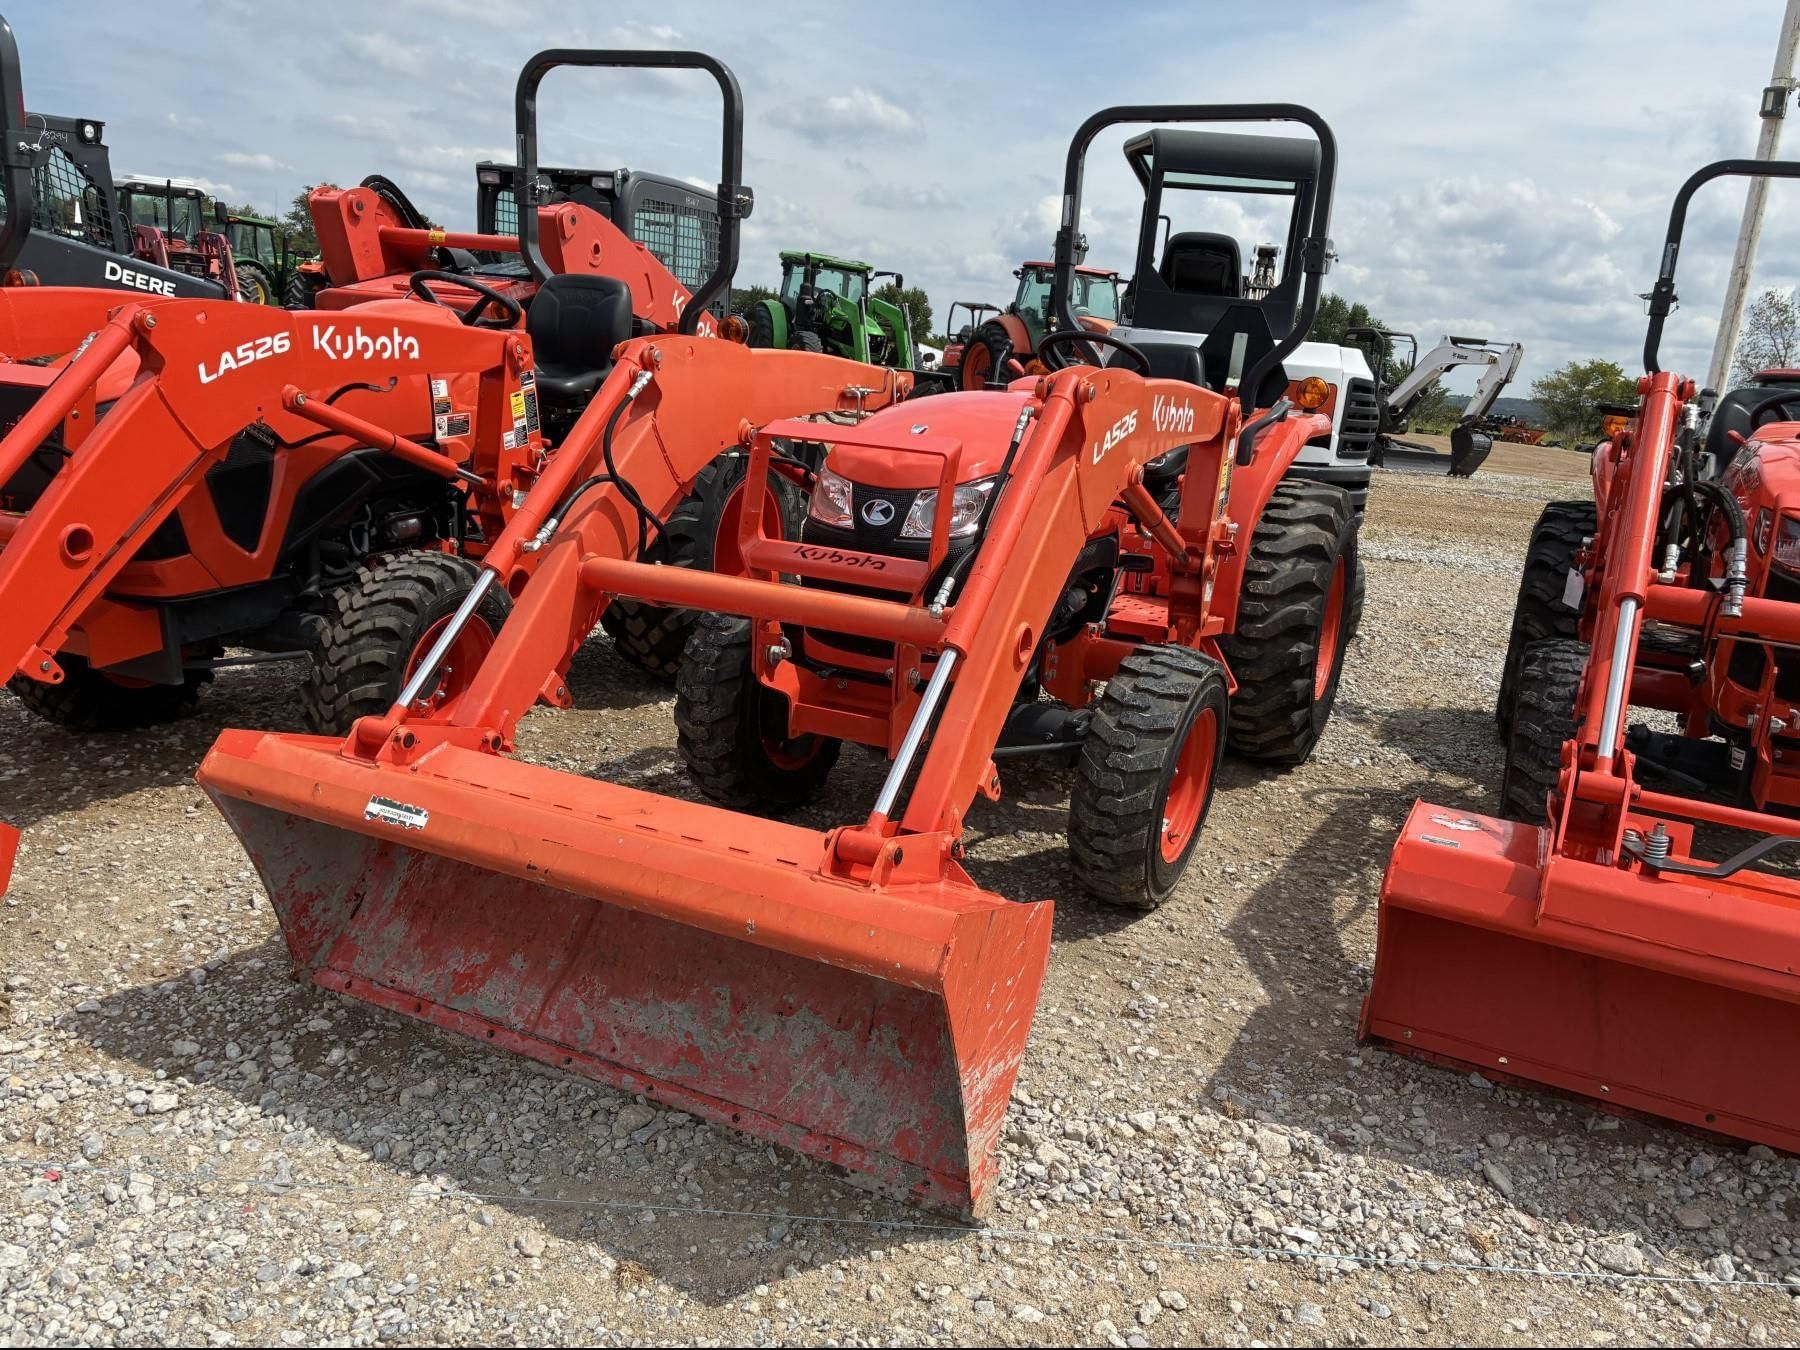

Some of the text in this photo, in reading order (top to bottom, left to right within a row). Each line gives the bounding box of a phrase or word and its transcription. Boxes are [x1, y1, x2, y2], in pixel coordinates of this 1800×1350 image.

[105, 260, 177, 298] DEERE
[198, 331, 291, 384] LA526
[312, 324, 420, 360] Kubota
[1152, 394, 1194, 432] Kubota
[1093, 408, 1139, 465] LA526
[793, 545, 887, 571] Kubota
